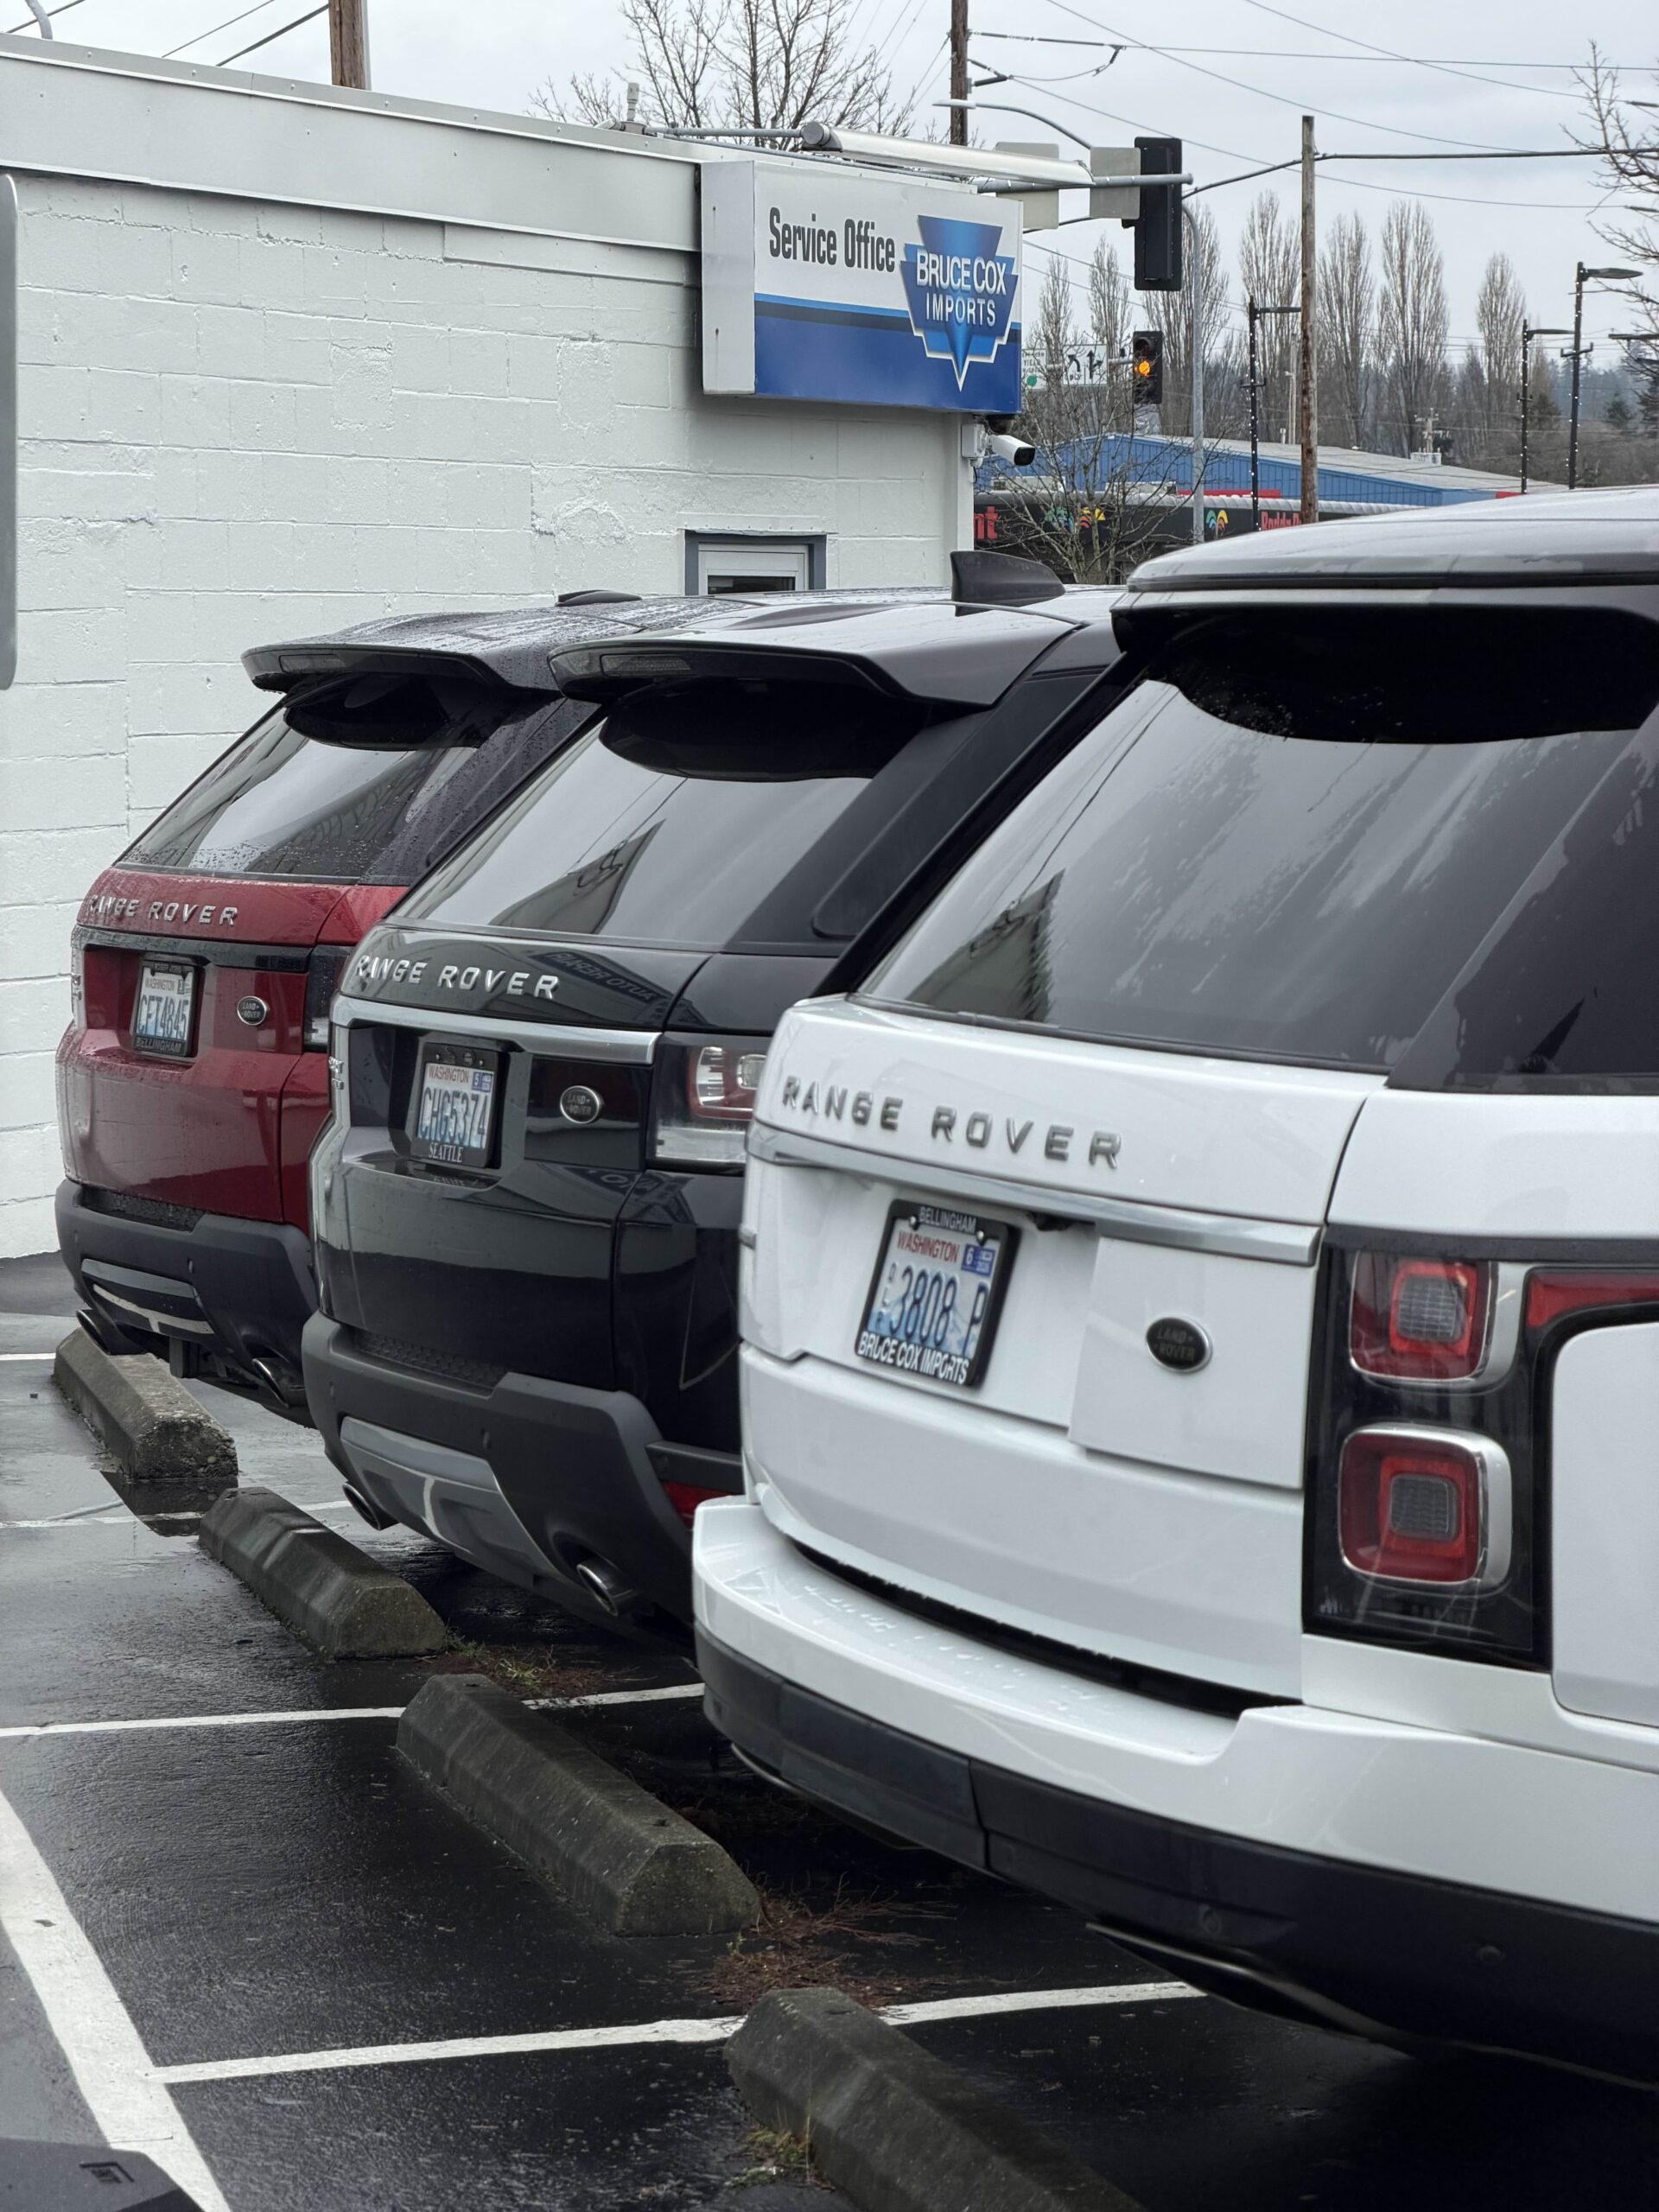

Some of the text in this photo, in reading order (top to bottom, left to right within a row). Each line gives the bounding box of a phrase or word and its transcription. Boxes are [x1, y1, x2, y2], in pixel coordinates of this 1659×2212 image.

[769, 207, 895, 273] Service Office
[916, 247, 1008, 296] BRUCE COX
[926, 291, 996, 327] IMPORTS
[148, 901, 238, 925] ROVER
[355, 955, 559, 1000] RANGE ROVER
[429, 1065, 469, 1084] WASHINGTON
[782, 1076, 1122, 1170] RANGE ROVER
[429, 1142, 463, 1163] SEATTLE
[918, 1206, 977, 1234] BELLINGHAM
[897, 1230, 961, 1263] WASHINGTON
[857, 1331, 969, 1384] BRUCE COX IMPORTS
